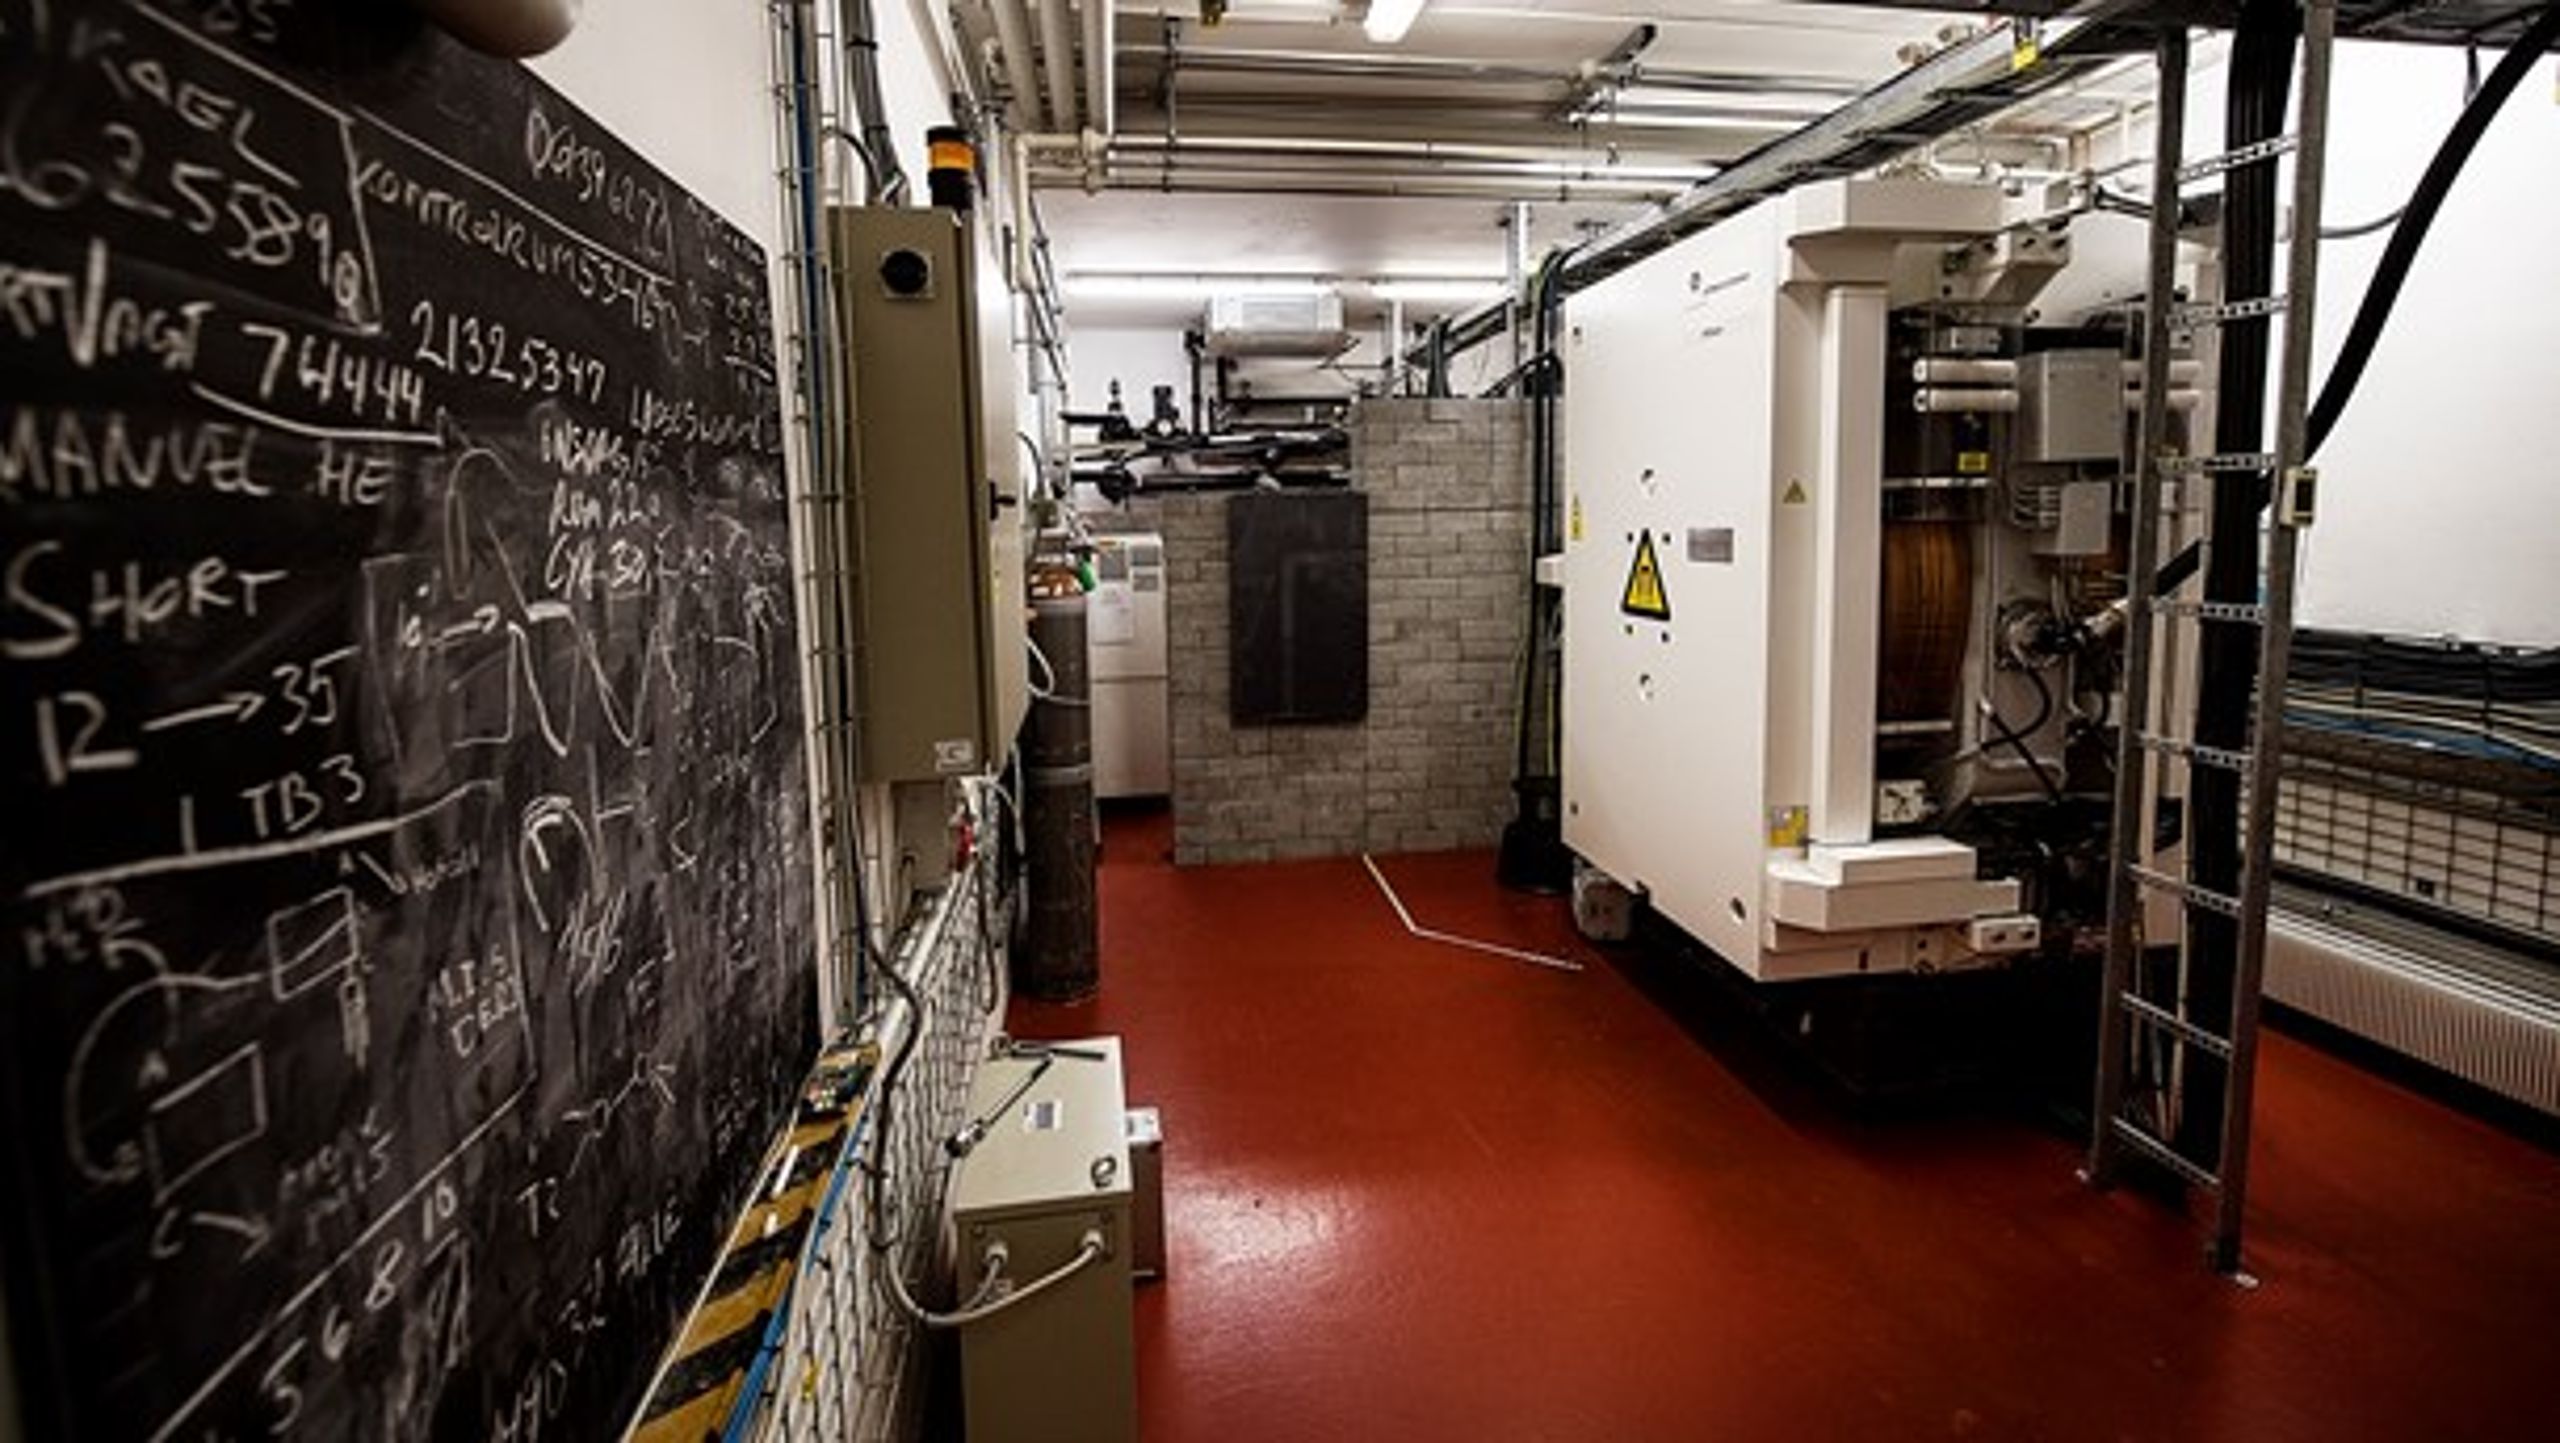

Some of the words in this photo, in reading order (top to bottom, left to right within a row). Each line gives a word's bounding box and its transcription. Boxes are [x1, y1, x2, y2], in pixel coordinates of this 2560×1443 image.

[411, 300, 606, 404] 21325347
[312, 438, 396, 505] HE
[0, 540, 290, 660] SHORT
[271, 644, 363, 736] 35
